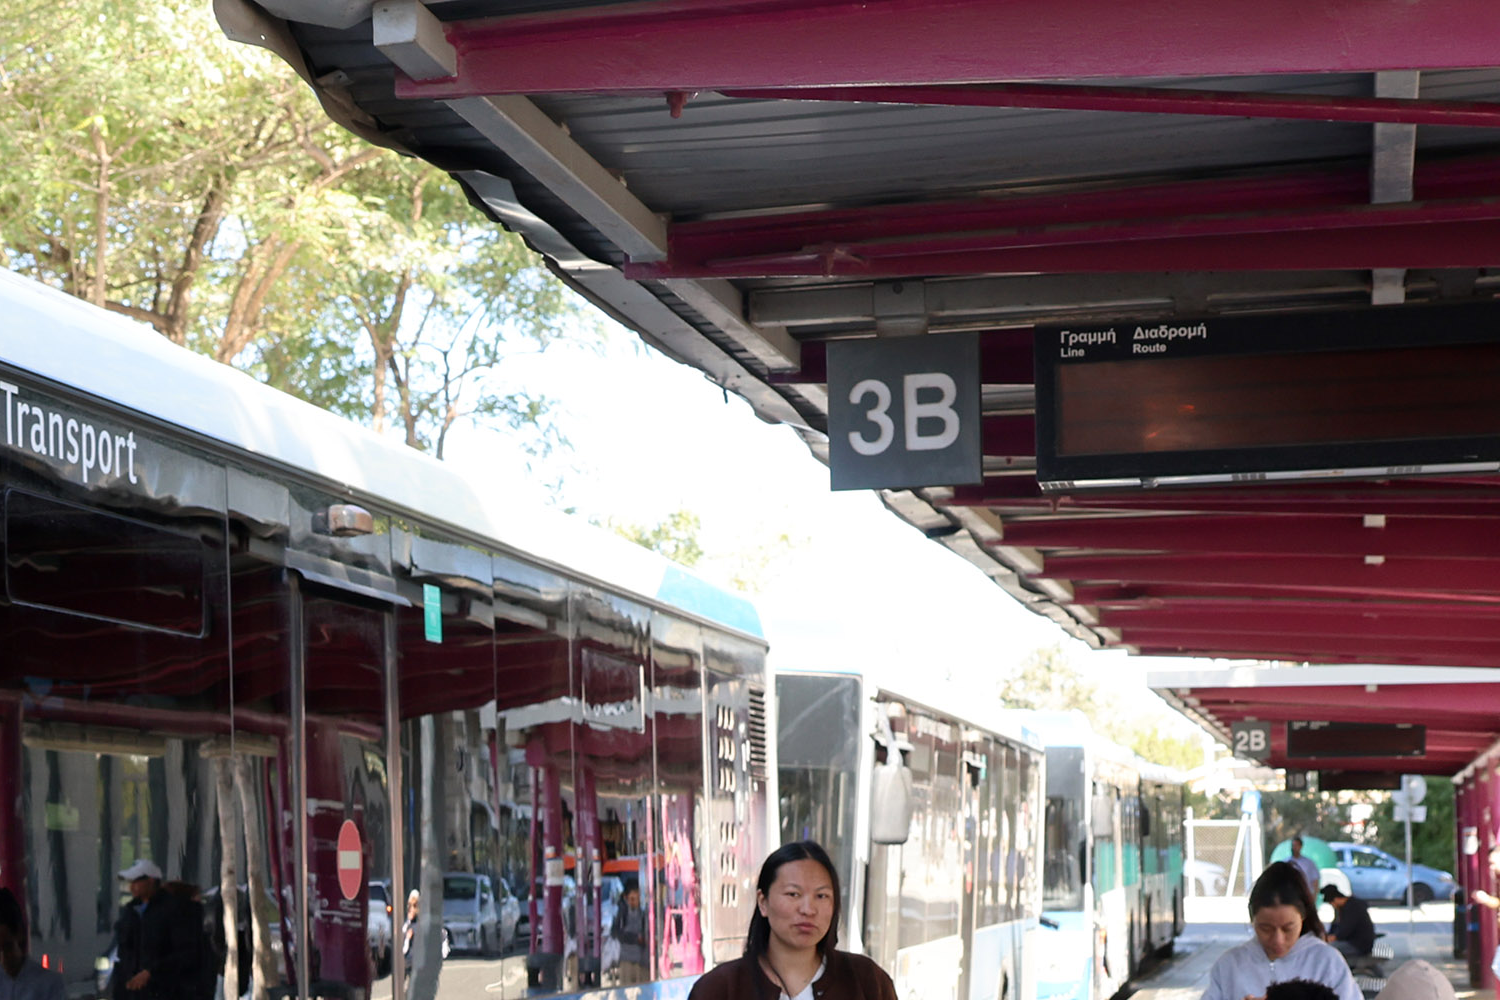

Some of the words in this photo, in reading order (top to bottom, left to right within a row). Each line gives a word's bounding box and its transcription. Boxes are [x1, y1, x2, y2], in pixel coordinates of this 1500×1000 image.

[1060, 328, 1117, 346] Γραμμή
[1133, 323, 1207, 341] Διαδρομή
[1060, 347, 1085, 358] Line
[1132, 343, 1167, 354] Route
[848, 372, 960, 456] 3B
[0, 380, 138, 485] Transport
[1235, 729, 1266, 751] 2B
